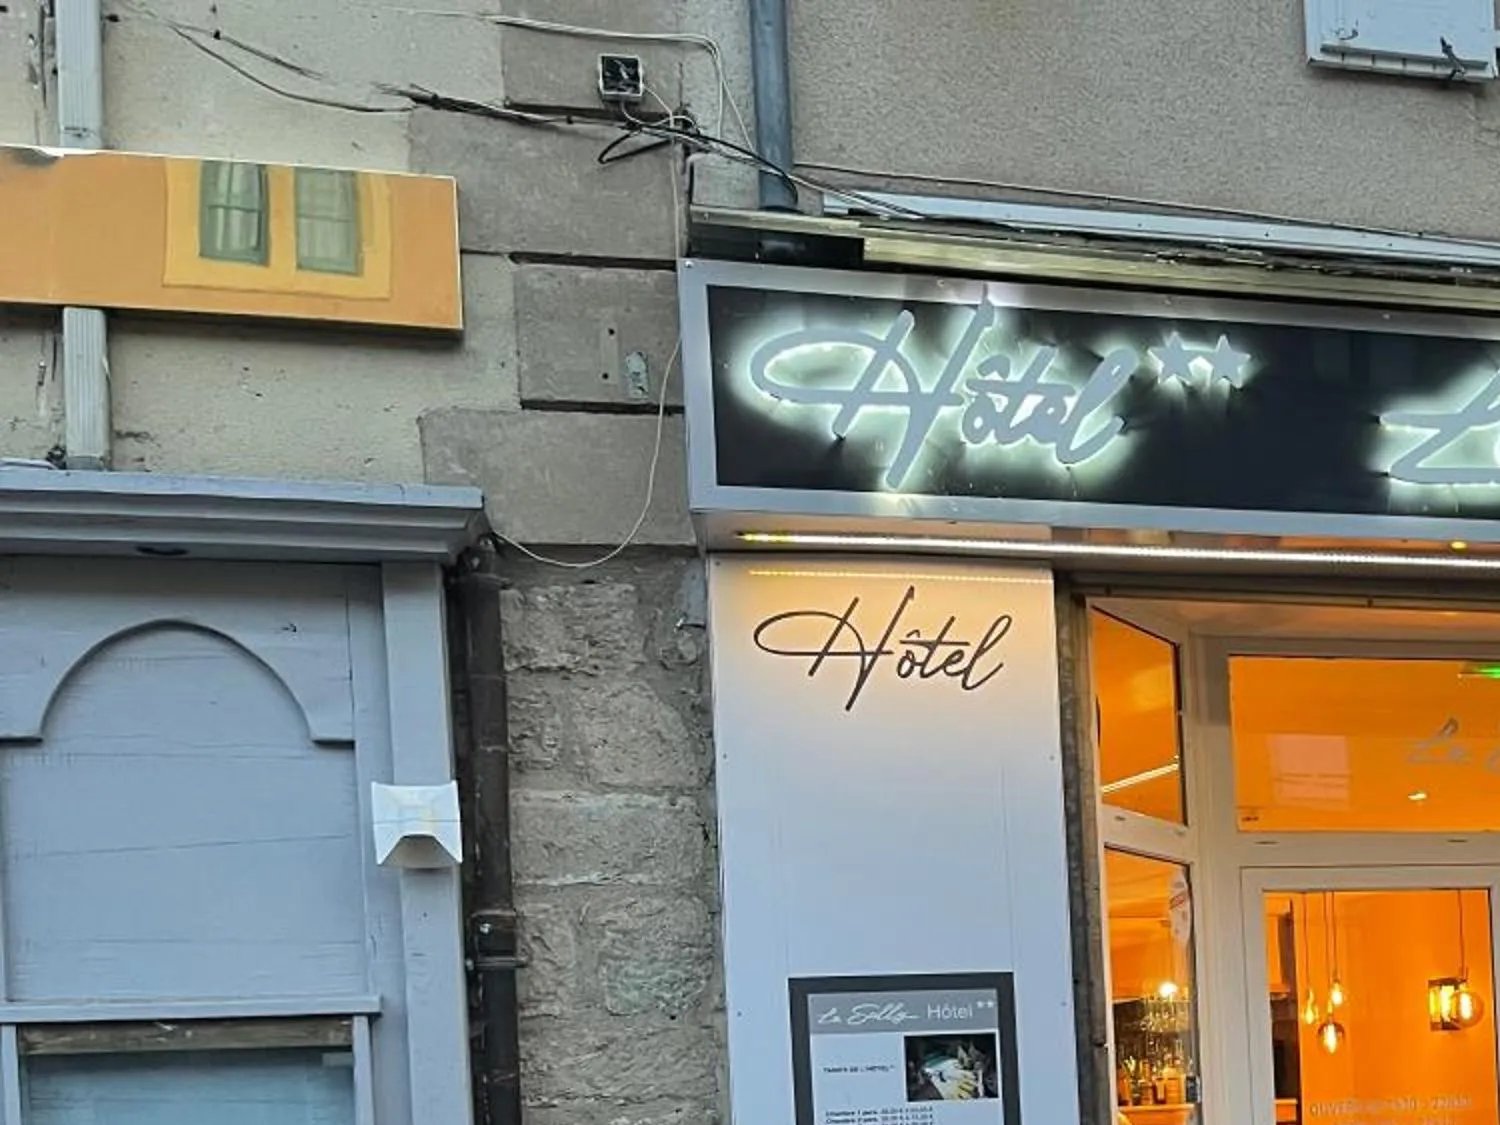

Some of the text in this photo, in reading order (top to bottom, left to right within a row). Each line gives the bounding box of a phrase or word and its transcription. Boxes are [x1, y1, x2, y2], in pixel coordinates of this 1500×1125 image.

[750, 284, 1138, 488] Hôtel
[754, 585, 1012, 711] Hôtel
[1407, 717, 1472, 764] Le
[928, 1003, 973, 1021] Hôtel
